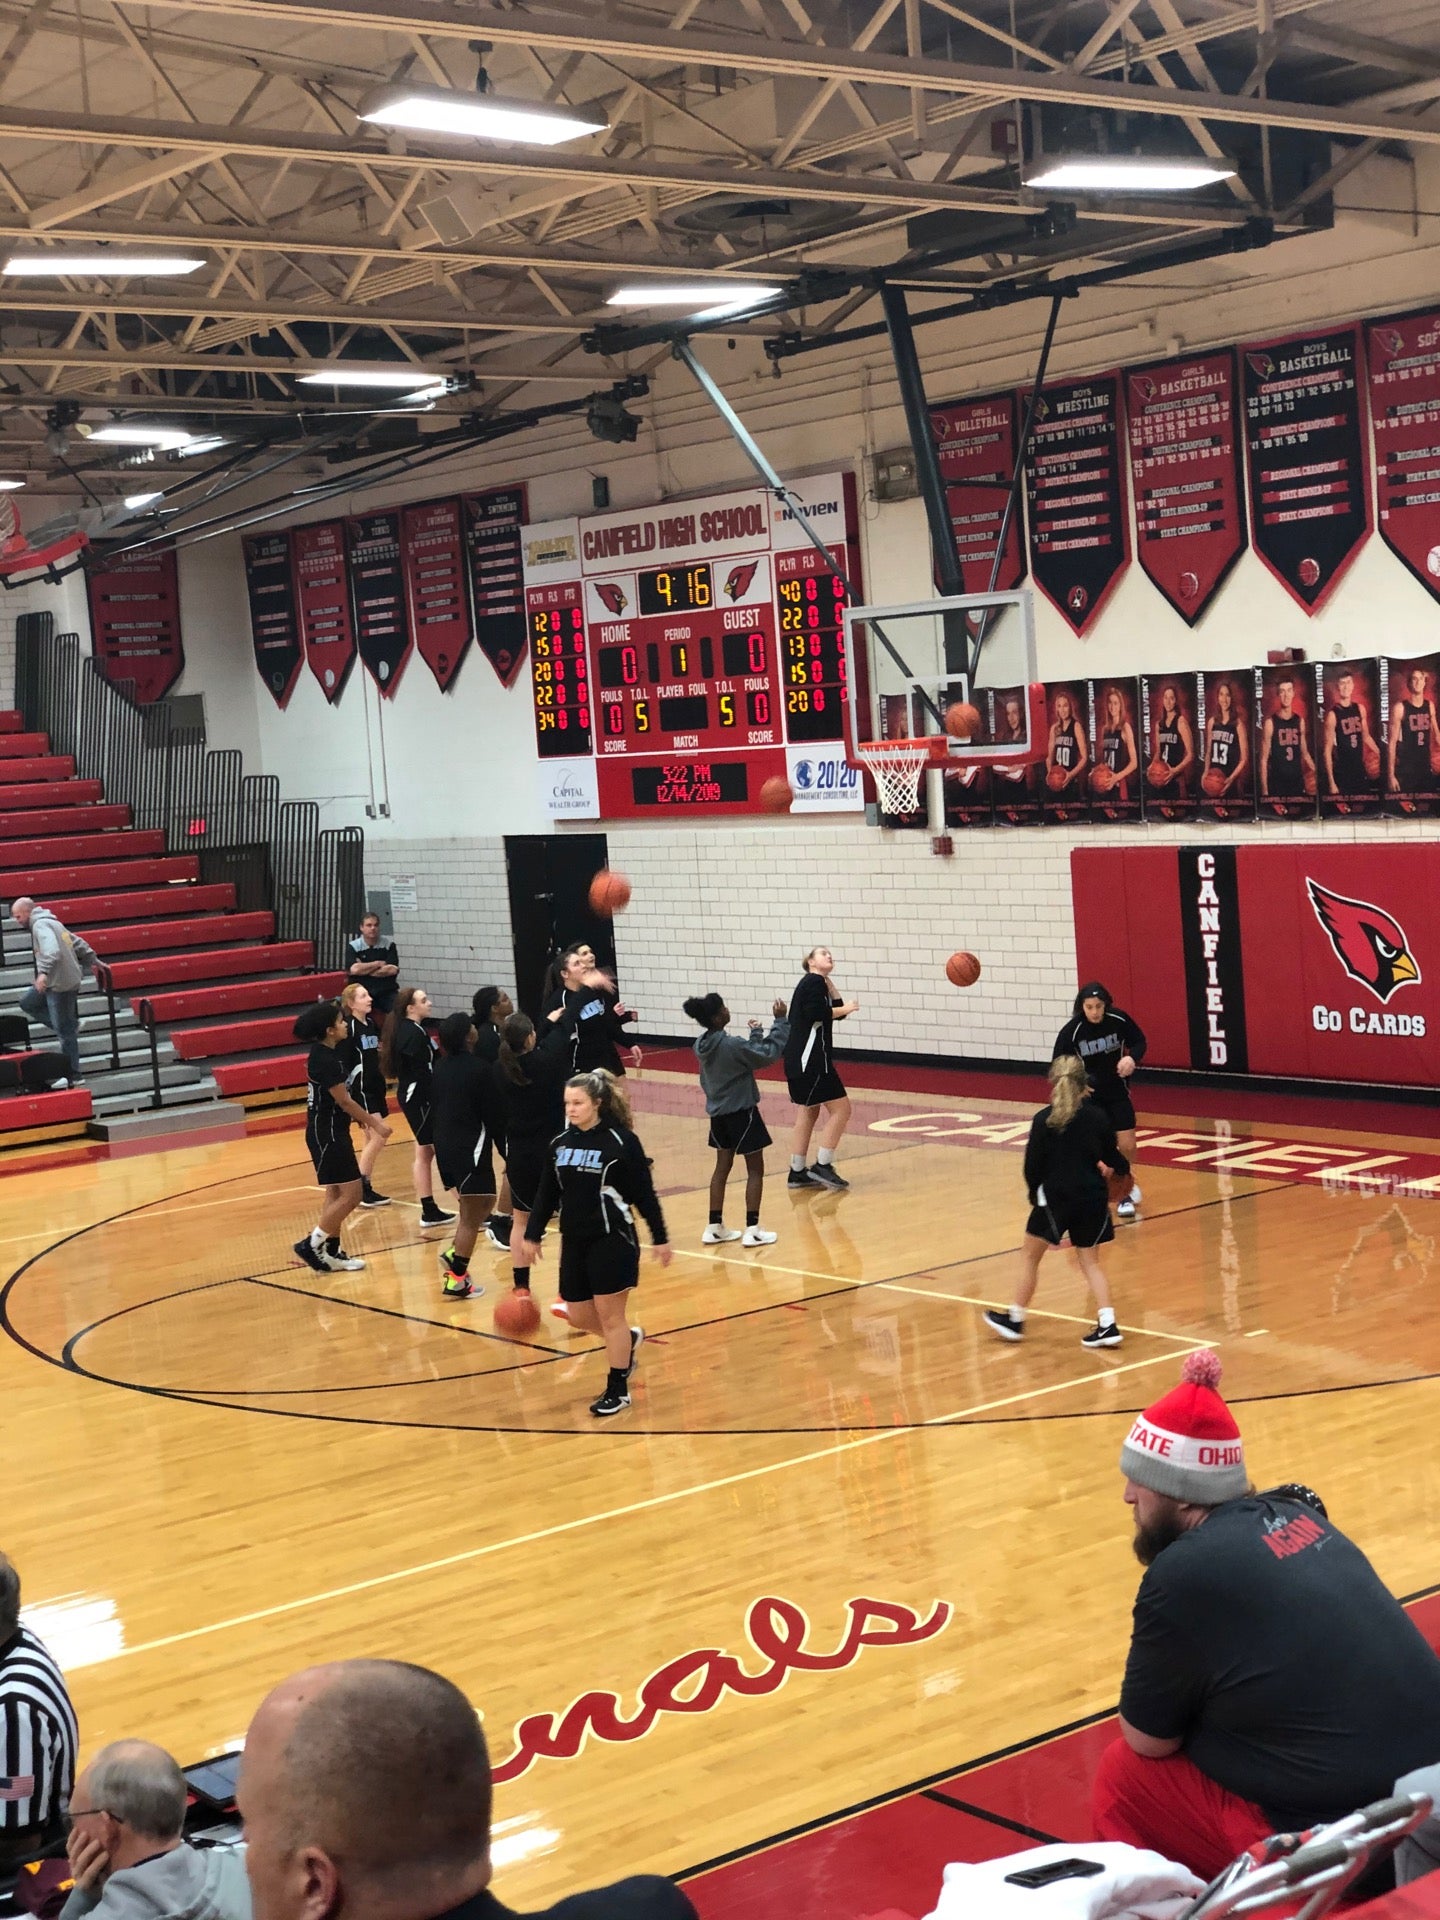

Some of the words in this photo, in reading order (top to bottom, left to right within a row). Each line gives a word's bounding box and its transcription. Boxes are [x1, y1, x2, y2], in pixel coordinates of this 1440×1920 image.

[1303, 342, 1327, 354] BOYS
[1417, 332, 1440, 348] SOF
[1280, 348, 1351, 373] BASKETBALL
[1181, 365, 1205, 377] GIRLS
[1161, 372, 1227, 395] BASKETBALL
[1056, 394, 1109, 414] WRESTLING
[955, 413, 1008, 433] VOLLEYBALL
[583, 521, 656, 561] CANFIELD
[658, 514, 697, 549] HIGH
[700, 503, 767, 543] SCHOOL
[779, 557, 796, 572] PLYR
[803, 555, 815, 569] FLS
[565, 588, 575, 600] PTS
[656, 567, 710, 606] 9:16
[780, 580, 801, 602] 40
[535, 612, 547, 632] 12
[723, 608, 760, 630] GUEST
[783, 607, 802, 630] 22
[601, 624, 631, 643] HOME
[664, 627, 691, 641] PERIOD
[537, 636, 550, 656] 15
[747, 633, 766, 673] 0
[789, 635, 805, 657] 13
[621, 647, 638, 684] 0
[680, 648, 686, 672] 1
[535, 662, 552, 682] 20
[791, 662, 807, 684] 15
[657, 685, 684, 698] PLAYER
[688, 682, 708, 696] FOUL
[715, 681, 737, 694] T.O.L.
[744, 677, 769, 691] FOULS
[1254, 668, 1263, 698] BECK
[1315, 664, 1325, 704] BRUNO
[536, 685, 553, 705] 22
[600, 690, 623, 703] FOULS
[630, 688, 650, 700] T.O.L.
[788, 690, 808, 713] 20
[720, 696, 734, 726] 5
[754, 693, 769, 724] 0
[1141, 678, 1151, 734] ORLOVSKY
[539, 711, 555, 731] 34
[609, 704, 623, 733] 0
[635, 702, 648, 731] 5
[604, 740, 627, 752] SCORE
[673, 735, 699, 748] MATCH
[747, 730, 774, 744] SCORE
[1278, 728, 1299, 746] CHS
[1211, 742, 1228, 765] 13
[1285, 746, 1294, 761] 3
[693, 764, 711, 782] PM
[1197, 853, 1227, 1065] CANFIELD
[1130, 1423, 1174, 1457] TATE
[1198, 1446, 1241, 1466] OHIO
